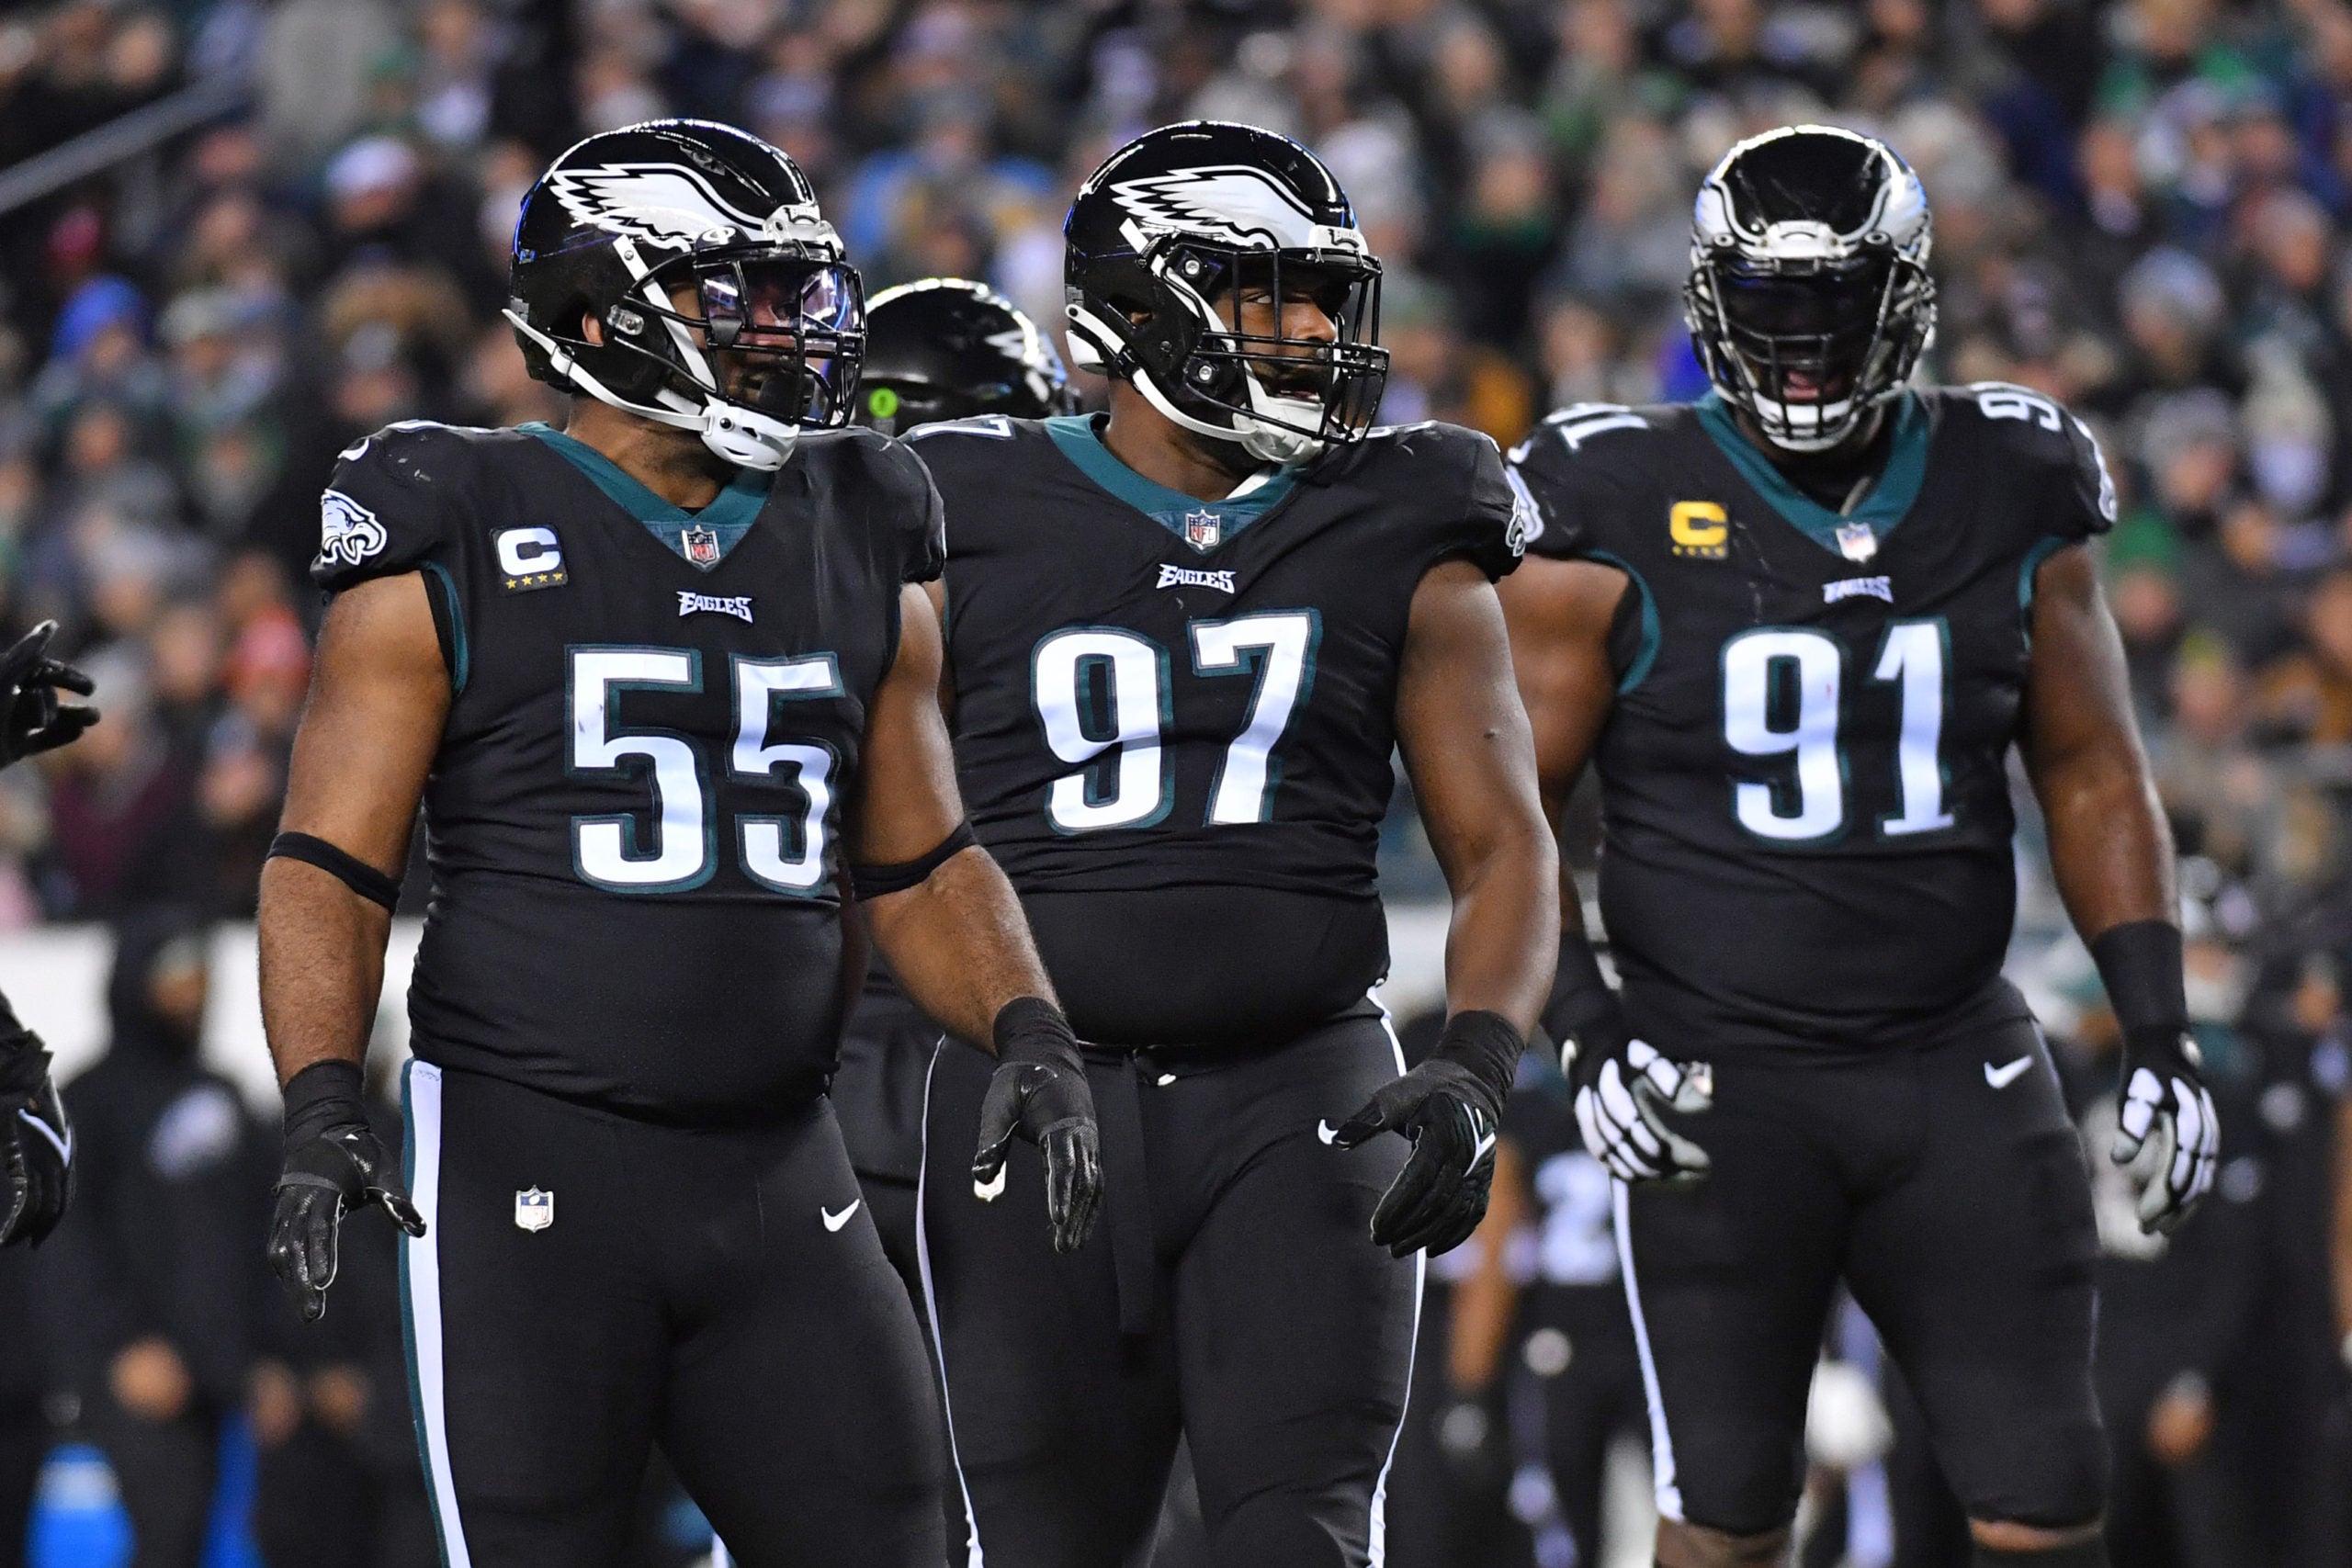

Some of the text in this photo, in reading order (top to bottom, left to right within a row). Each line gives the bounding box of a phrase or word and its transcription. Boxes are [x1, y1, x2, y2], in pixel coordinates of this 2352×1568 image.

[1670, 501, 1727, 547] C
[497, 527, 560, 576] C
[1156, 563, 1236, 594] EAGLES
[676, 591, 753, 624] EAGLES
[1031, 608, 1321, 834] 97
[1720, 617, 1955, 843] 91
[565, 644, 842, 897] 55
